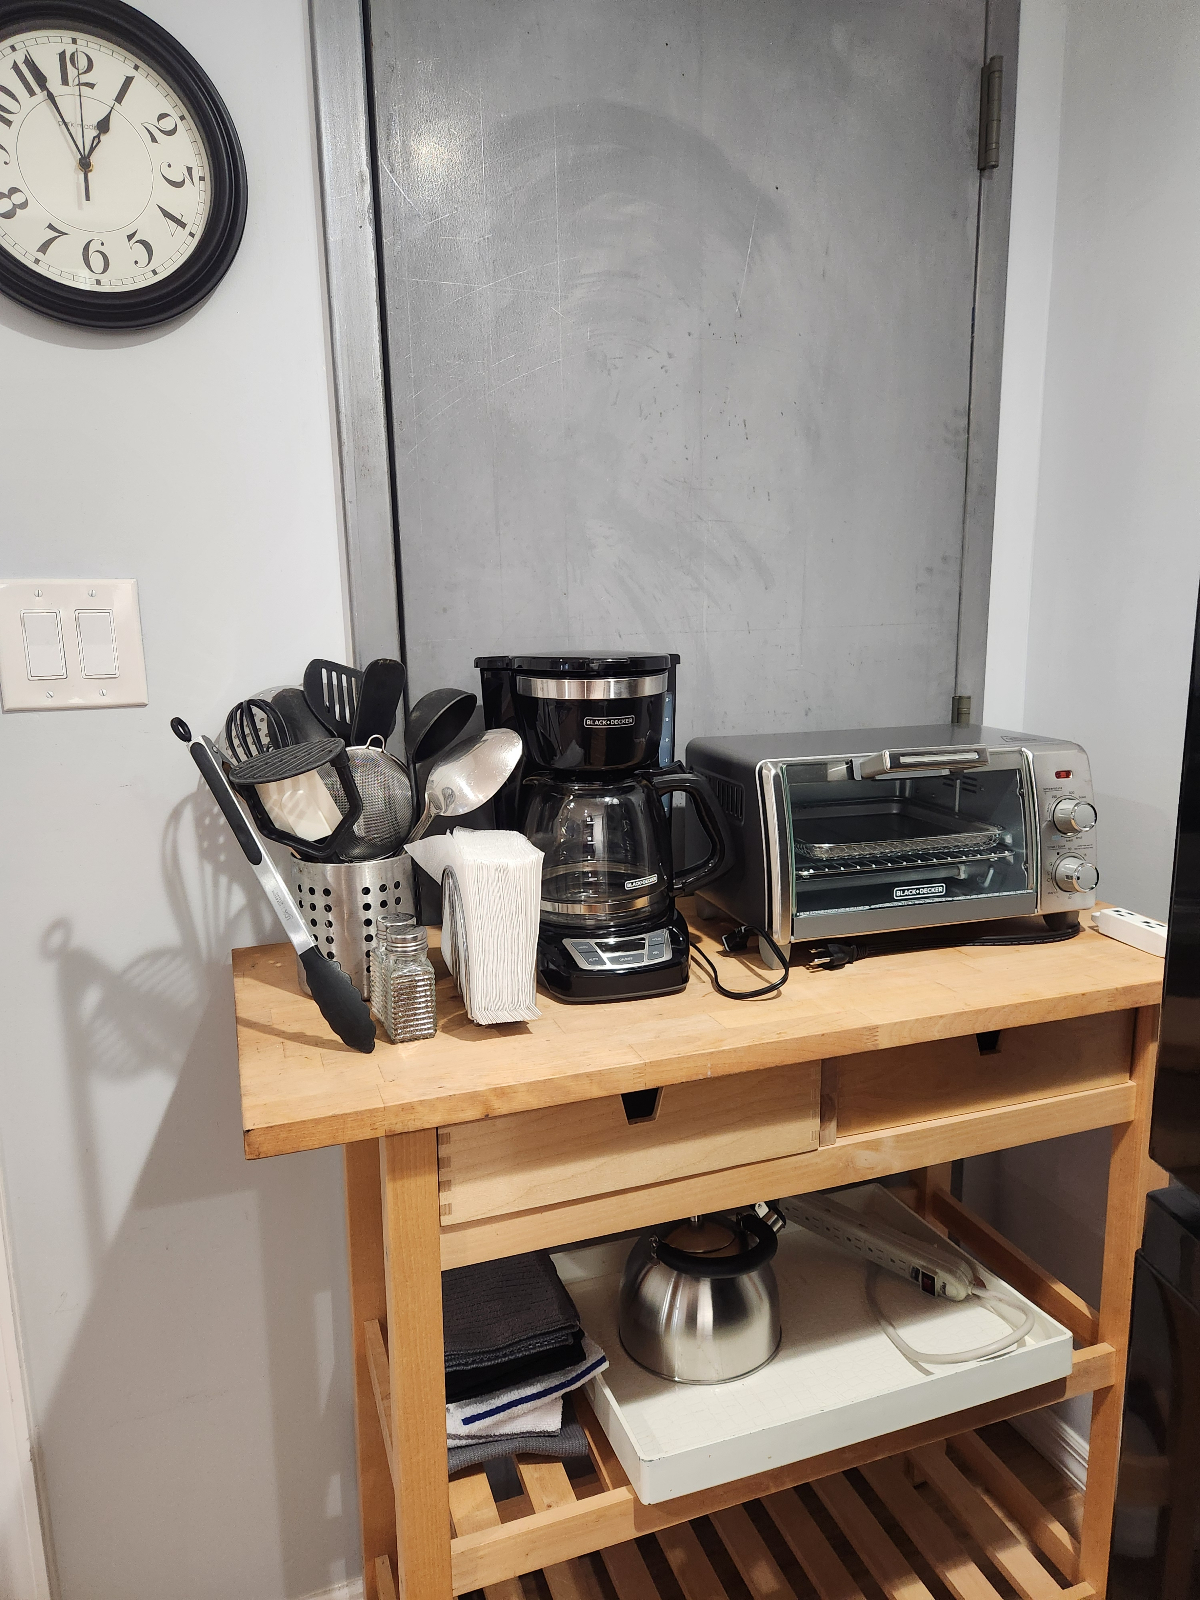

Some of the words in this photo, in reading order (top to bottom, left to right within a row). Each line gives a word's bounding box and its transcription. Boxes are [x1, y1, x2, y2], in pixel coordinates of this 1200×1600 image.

[10, 53, 47, 98] 11
[56, 48, 98, 90] 12
[112, 75, 136, 106] 1
[140, 112, 178, 145] 2
[159, 160, 196, 189] 3
[0, 186, 29, 220] 8
[156, 203, 189, 238] 4
[36, 222, 71, 256] 7
[126, 229, 154, 269] 5
[82, 238, 110, 275] 6
[586, 717, 633, 726] BLACK+DECKER
[896, 885, 943, 897] BLACK+DECKER
